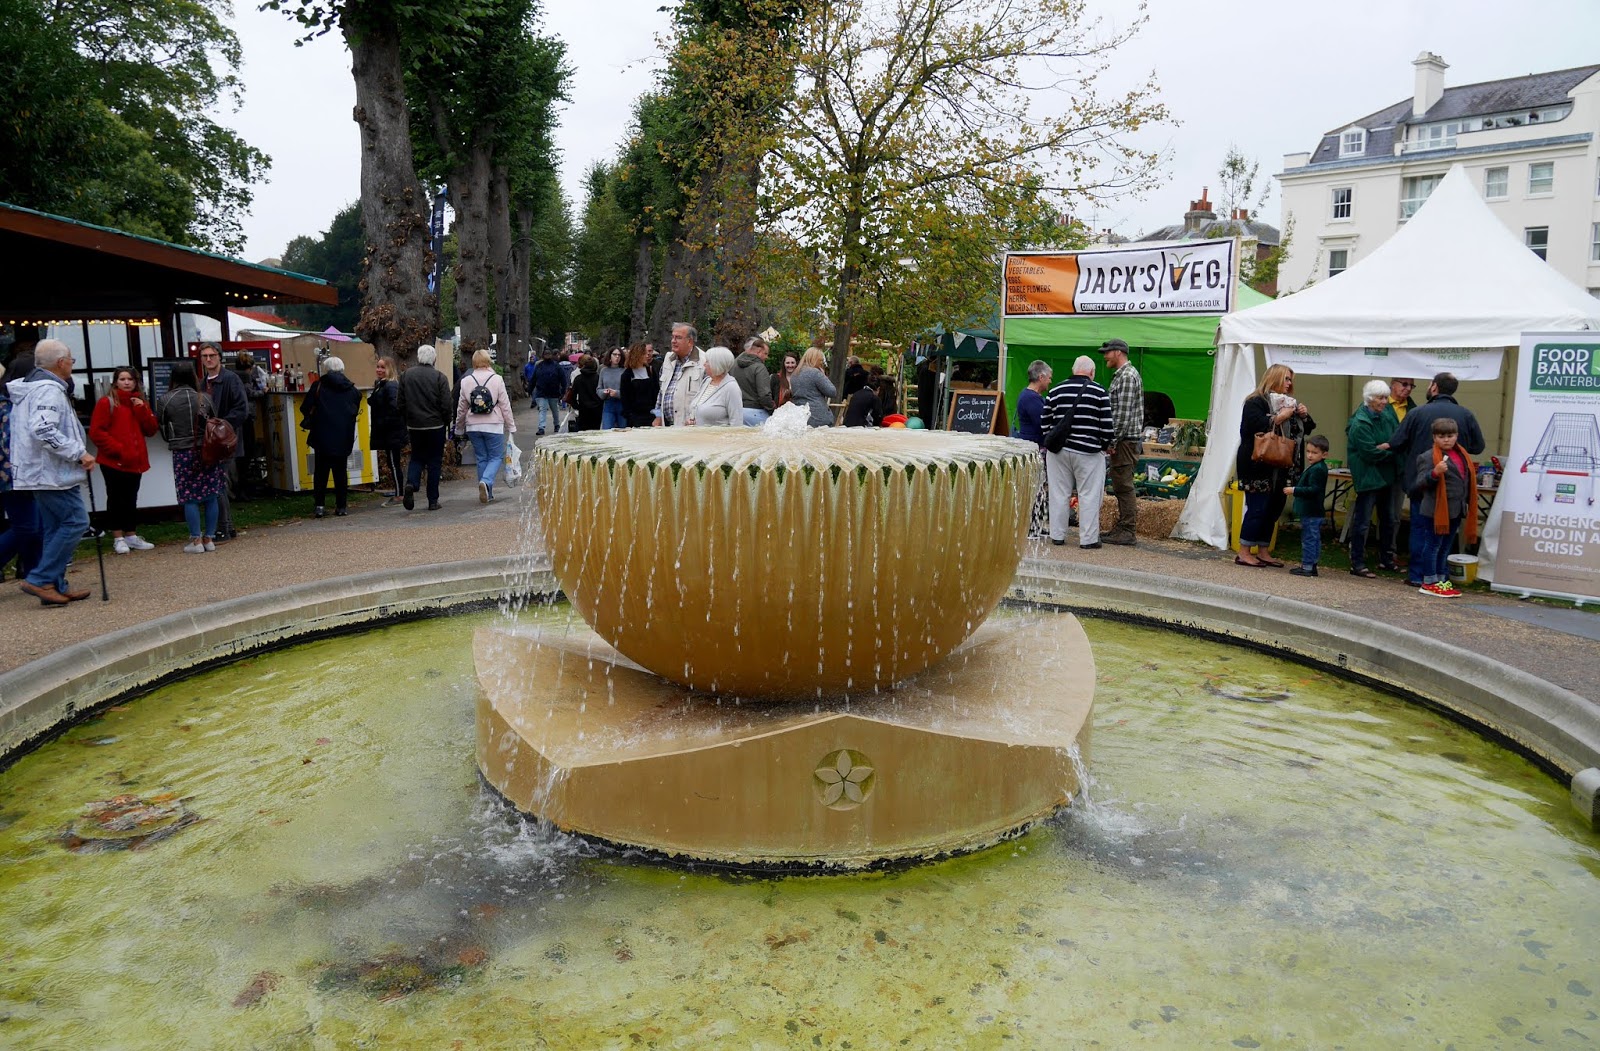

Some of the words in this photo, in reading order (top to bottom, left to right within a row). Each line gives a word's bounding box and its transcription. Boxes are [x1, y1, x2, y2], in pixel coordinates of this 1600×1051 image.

[1080, 263, 1159, 294] JACK'S
[1169, 259, 1226, 291] VEG.
[1008, 304, 1026, 312] MICRO
[1538, 349, 1590, 362] FOOD
[1537, 362, 1588, 375] BANK
[1520, 526, 1565, 541] FOOD
[1569, 531, 1586, 543] IN
[1589, 533, 1600, 544] A
[1534, 541, 1584, 556] CRISIS
